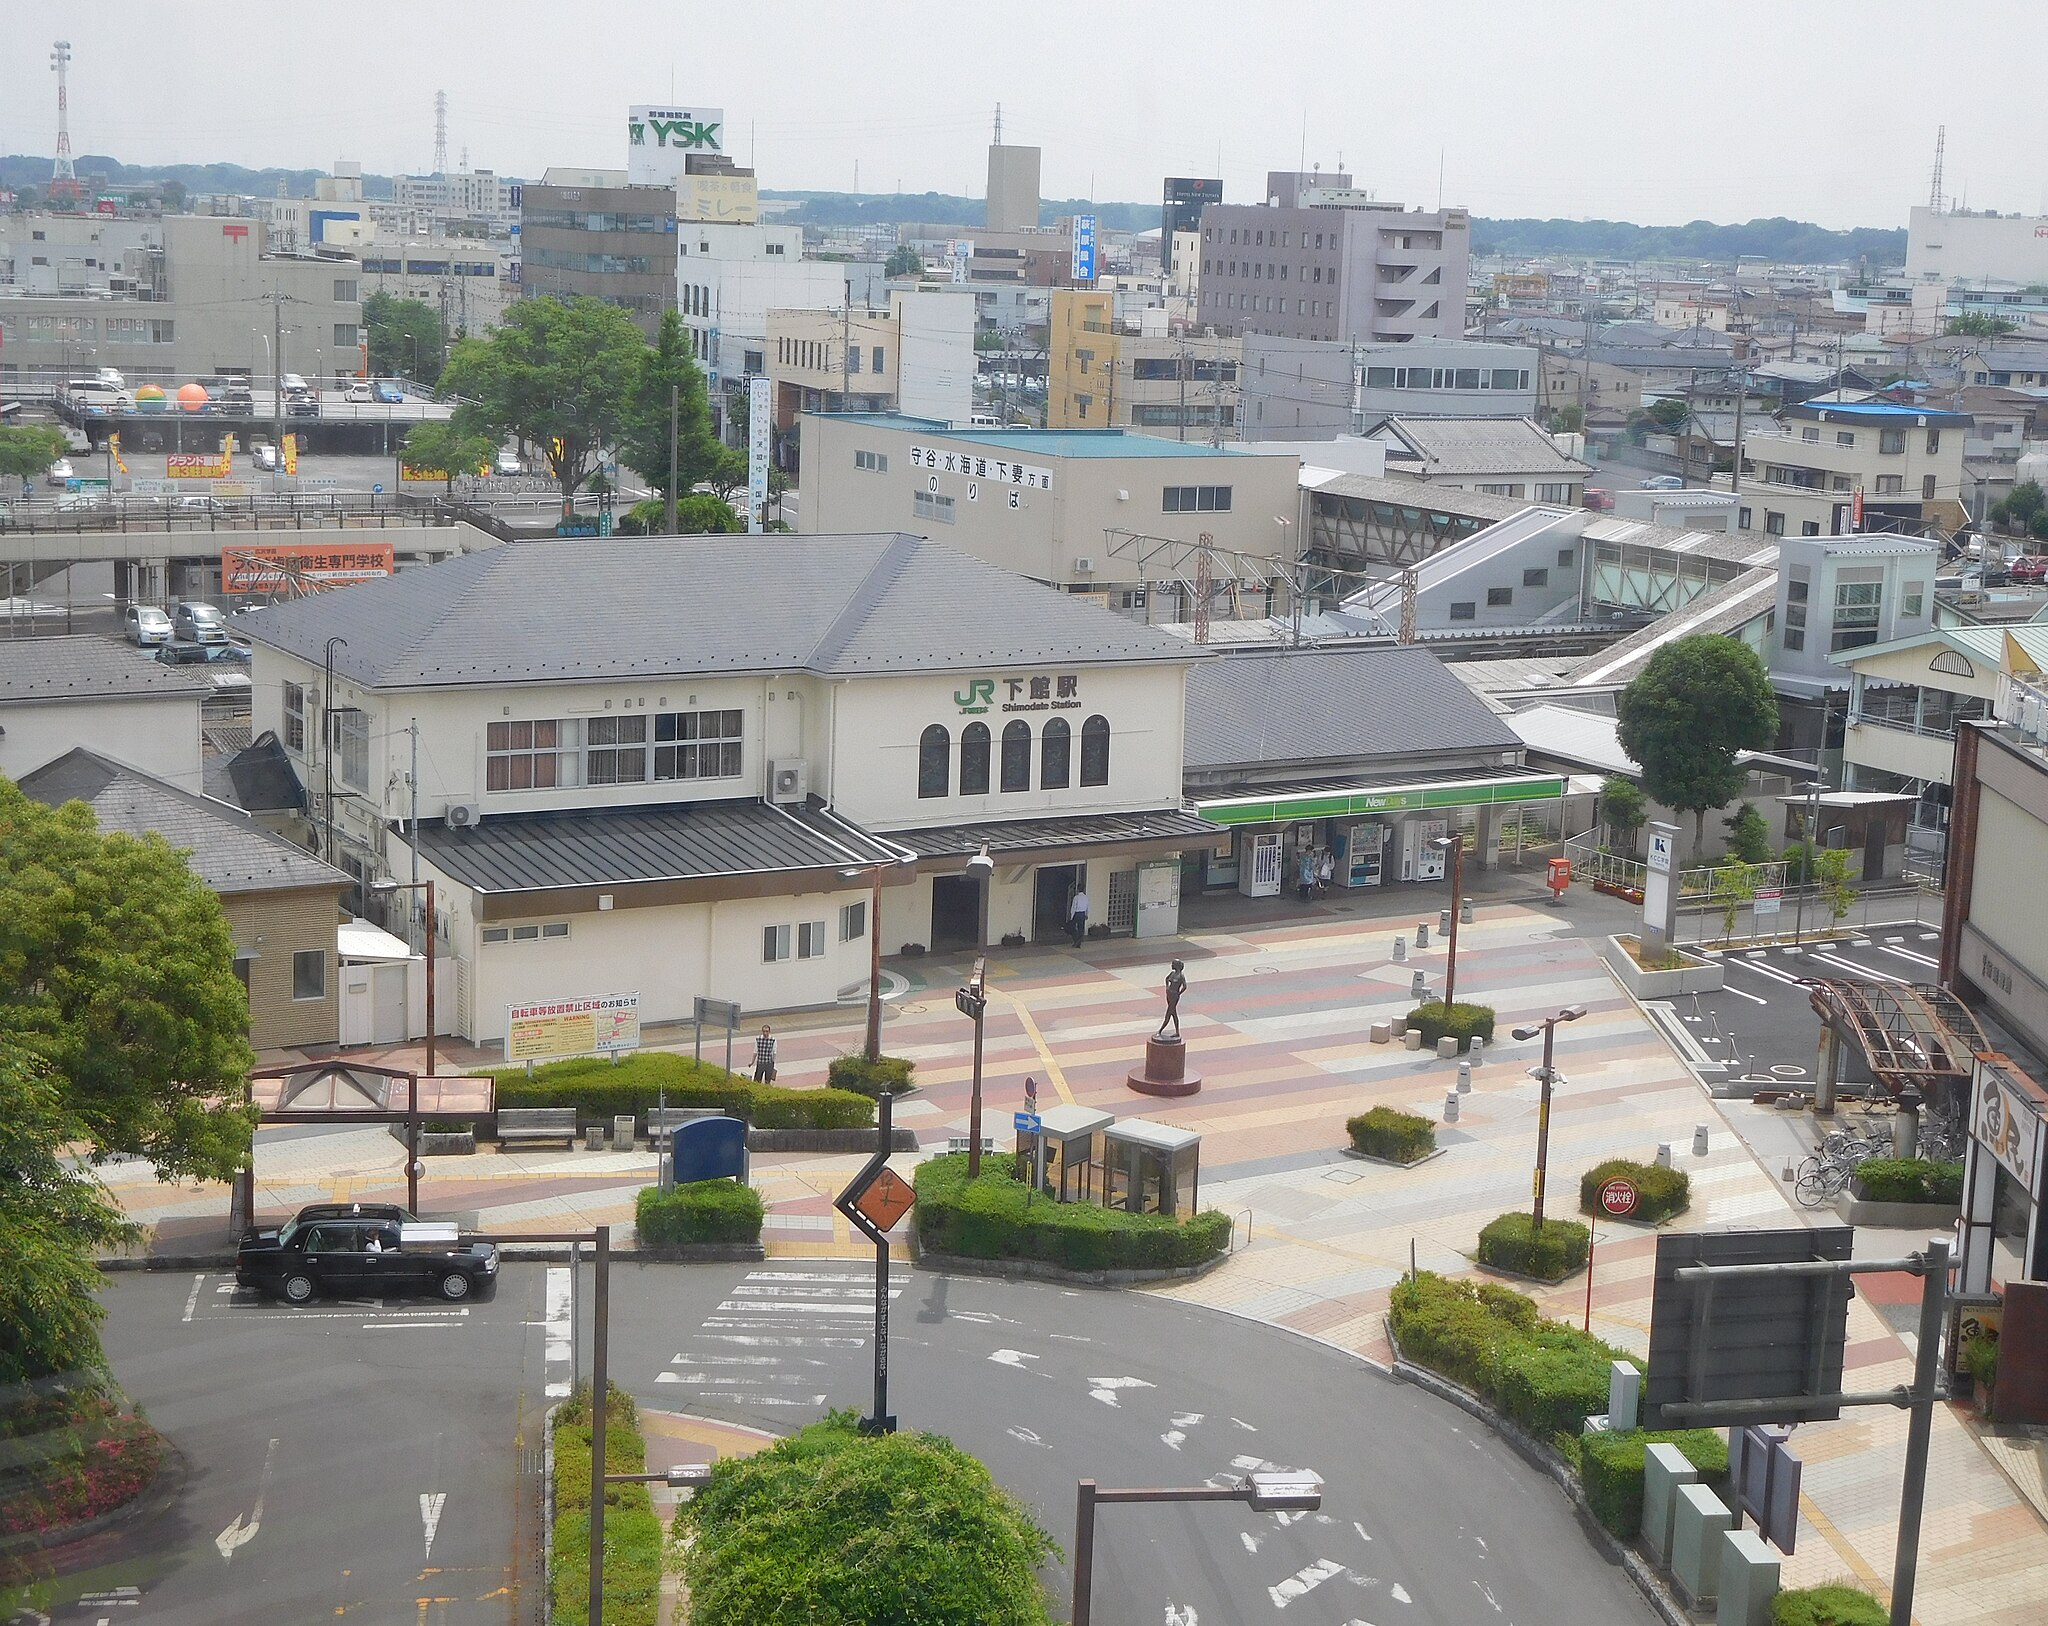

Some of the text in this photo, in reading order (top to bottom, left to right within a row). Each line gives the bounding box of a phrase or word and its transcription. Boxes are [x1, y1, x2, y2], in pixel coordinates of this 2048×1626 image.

[648, 120, 720, 149] YSK
[697, 199, 753, 216] ミレー
[954, 679, 995, 706] JR
[1003, 675, 1078, 701] 下館駅
[1002, 700, 1082, 712] Shimodate Station
[1365, 797, 1407, 808] NewDs
[511, 998, 637, 1018] 自転車等放置禁止区域のお知らせ
[1605, 1191, 1632, 1204] 消火栓
